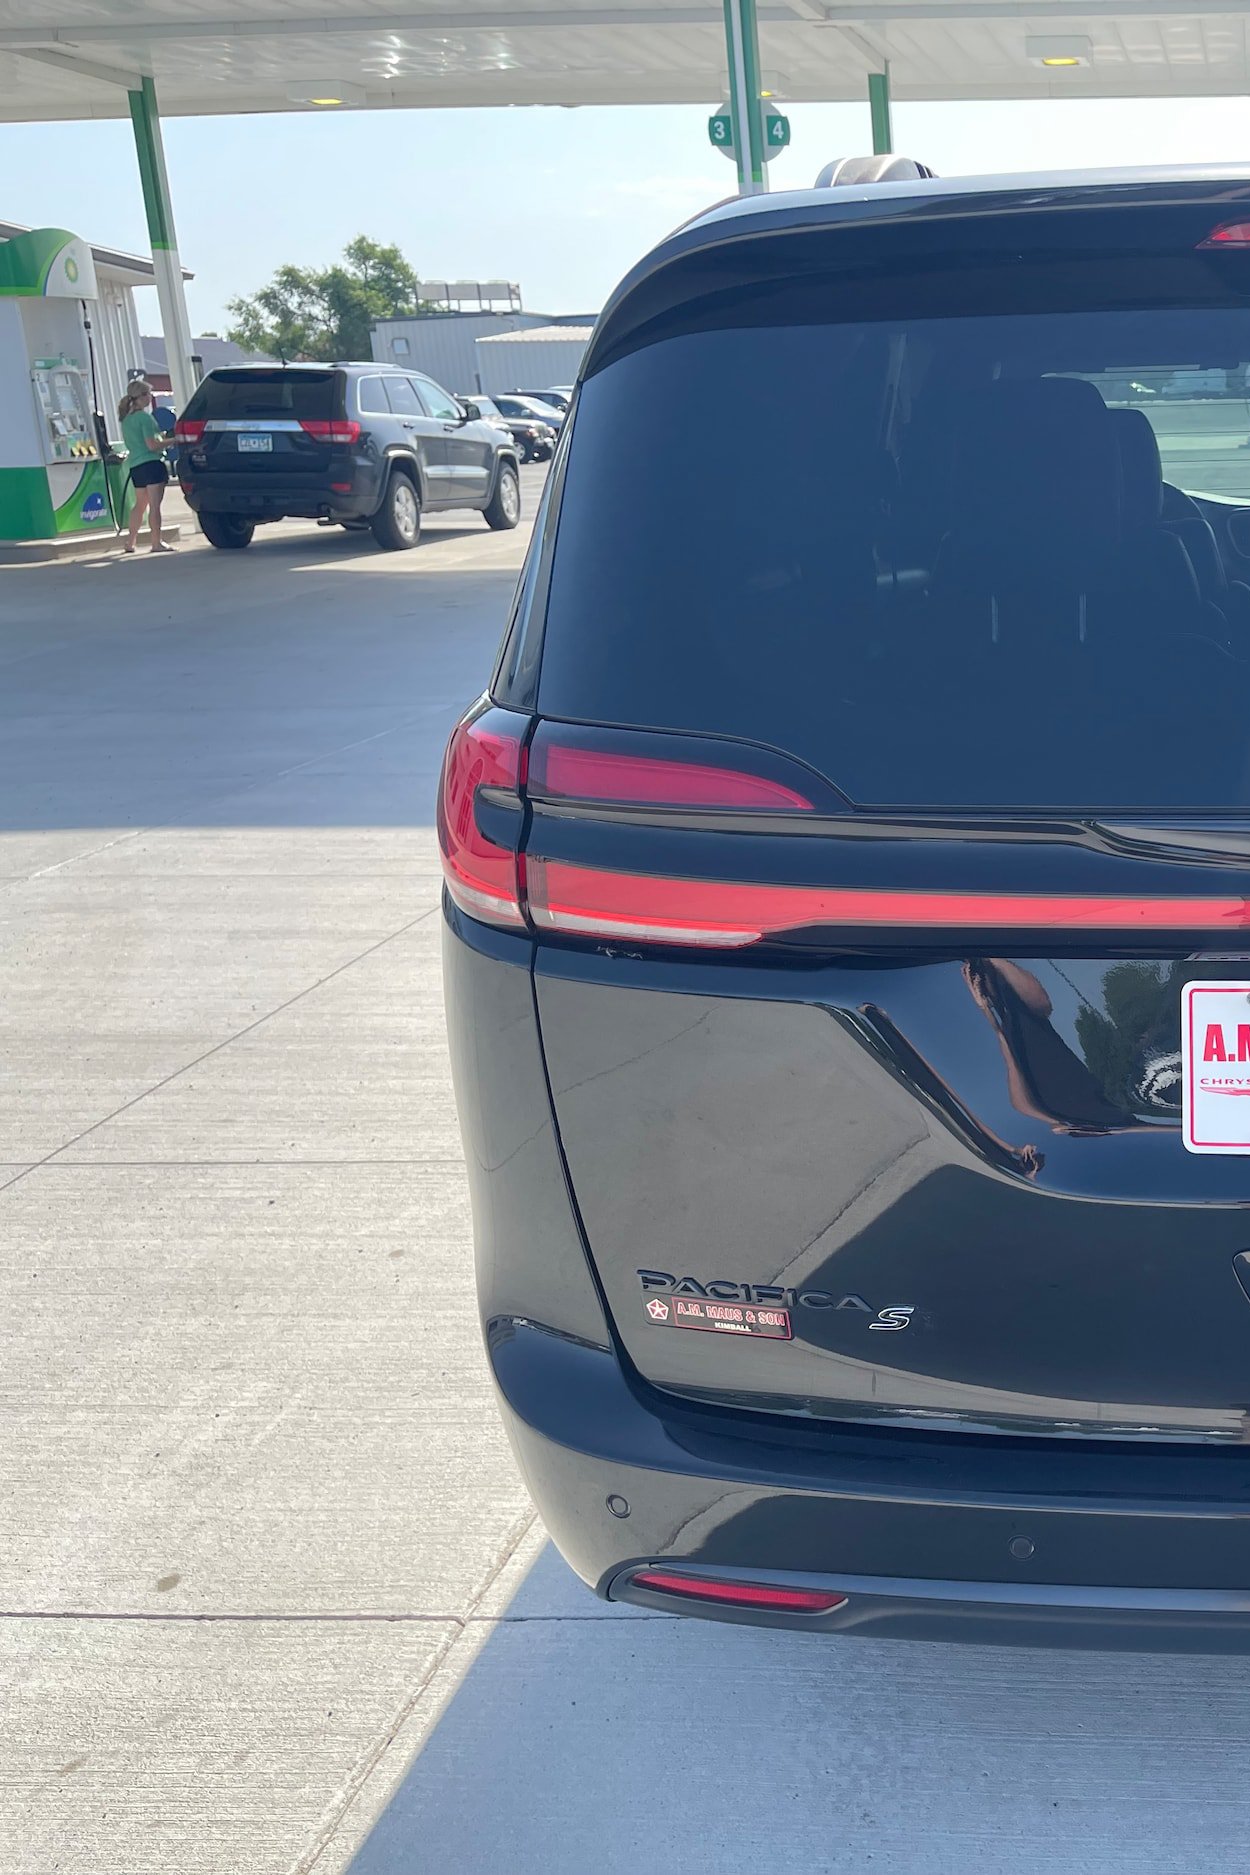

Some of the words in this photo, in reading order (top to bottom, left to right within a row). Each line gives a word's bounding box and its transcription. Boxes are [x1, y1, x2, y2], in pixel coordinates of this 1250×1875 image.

[714, 121, 725, 139] 3
[773, 121, 784, 139] 4
[636, 1269, 874, 1313] PACIFICA
[677, 1302, 704, 1317] A.M.
[706, 1305, 743, 1322] MAUS
[745, 1311, 757, 1323] &
[758, 1311, 786, 1327] SON
[868, 1306, 915, 1330] S
[714, 1322, 752, 1332] KIMBALL
